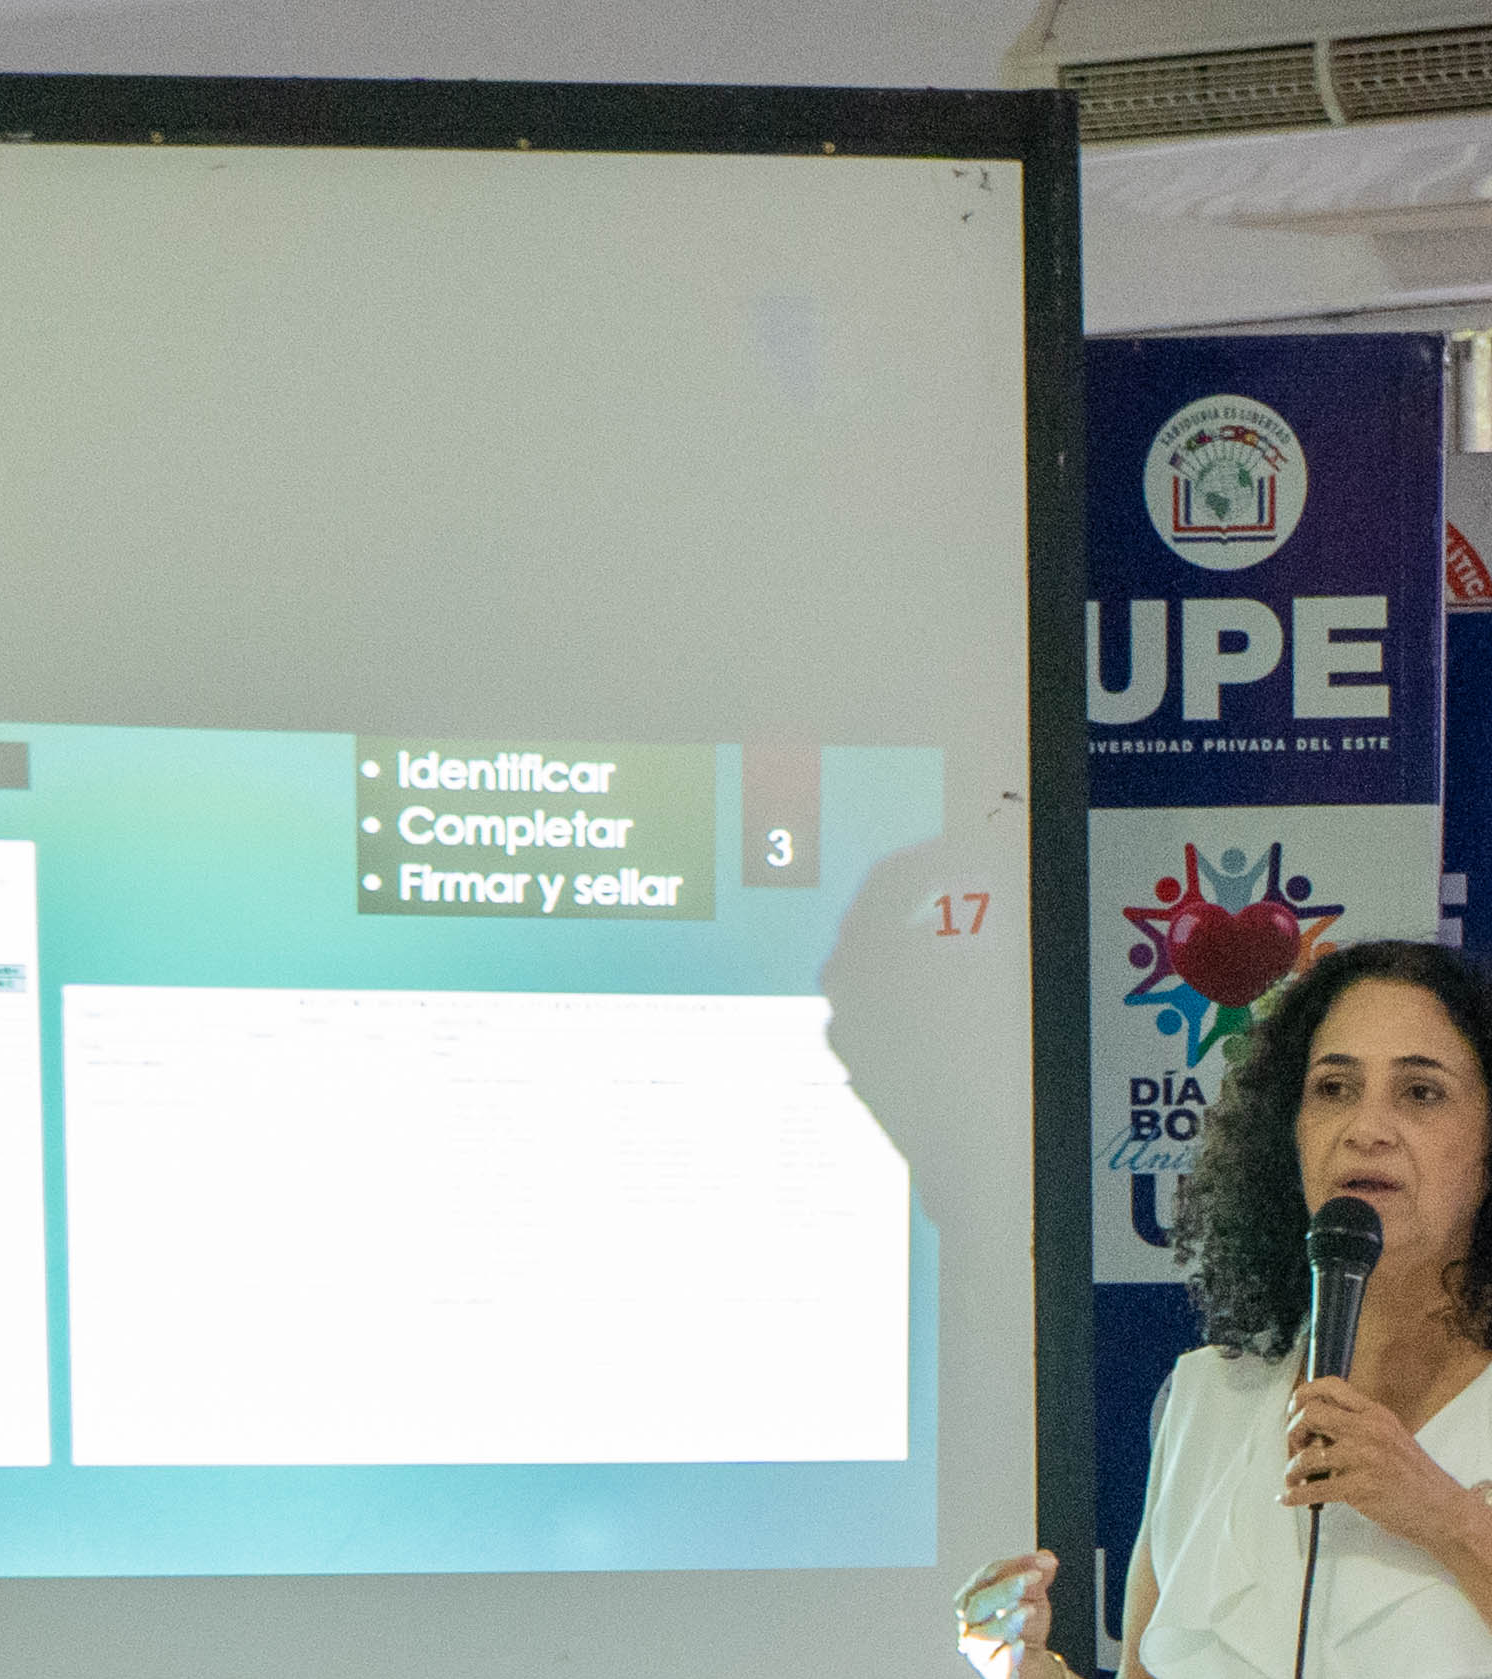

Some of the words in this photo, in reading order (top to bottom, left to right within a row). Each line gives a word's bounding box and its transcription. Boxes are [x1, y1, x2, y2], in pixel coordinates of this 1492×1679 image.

[1085, 596, 1390, 725] UPE
[1204, 738, 1286, 752] PRIVADA
[1296, 738, 1331, 751] DEL
[1342, 736, 1390, 750] ESTE
[397, 750, 616, 793] Identificar
[397, 806, 634, 856] Completar
[766, 828, 794, 868] 3
[398, 863, 532, 904] Firmar
[537, 873, 565, 914] y
[573, 868, 684, 907] sellar
[934, 892, 990, 936] 17
[1130, 1070, 1207, 1106] DÍA
